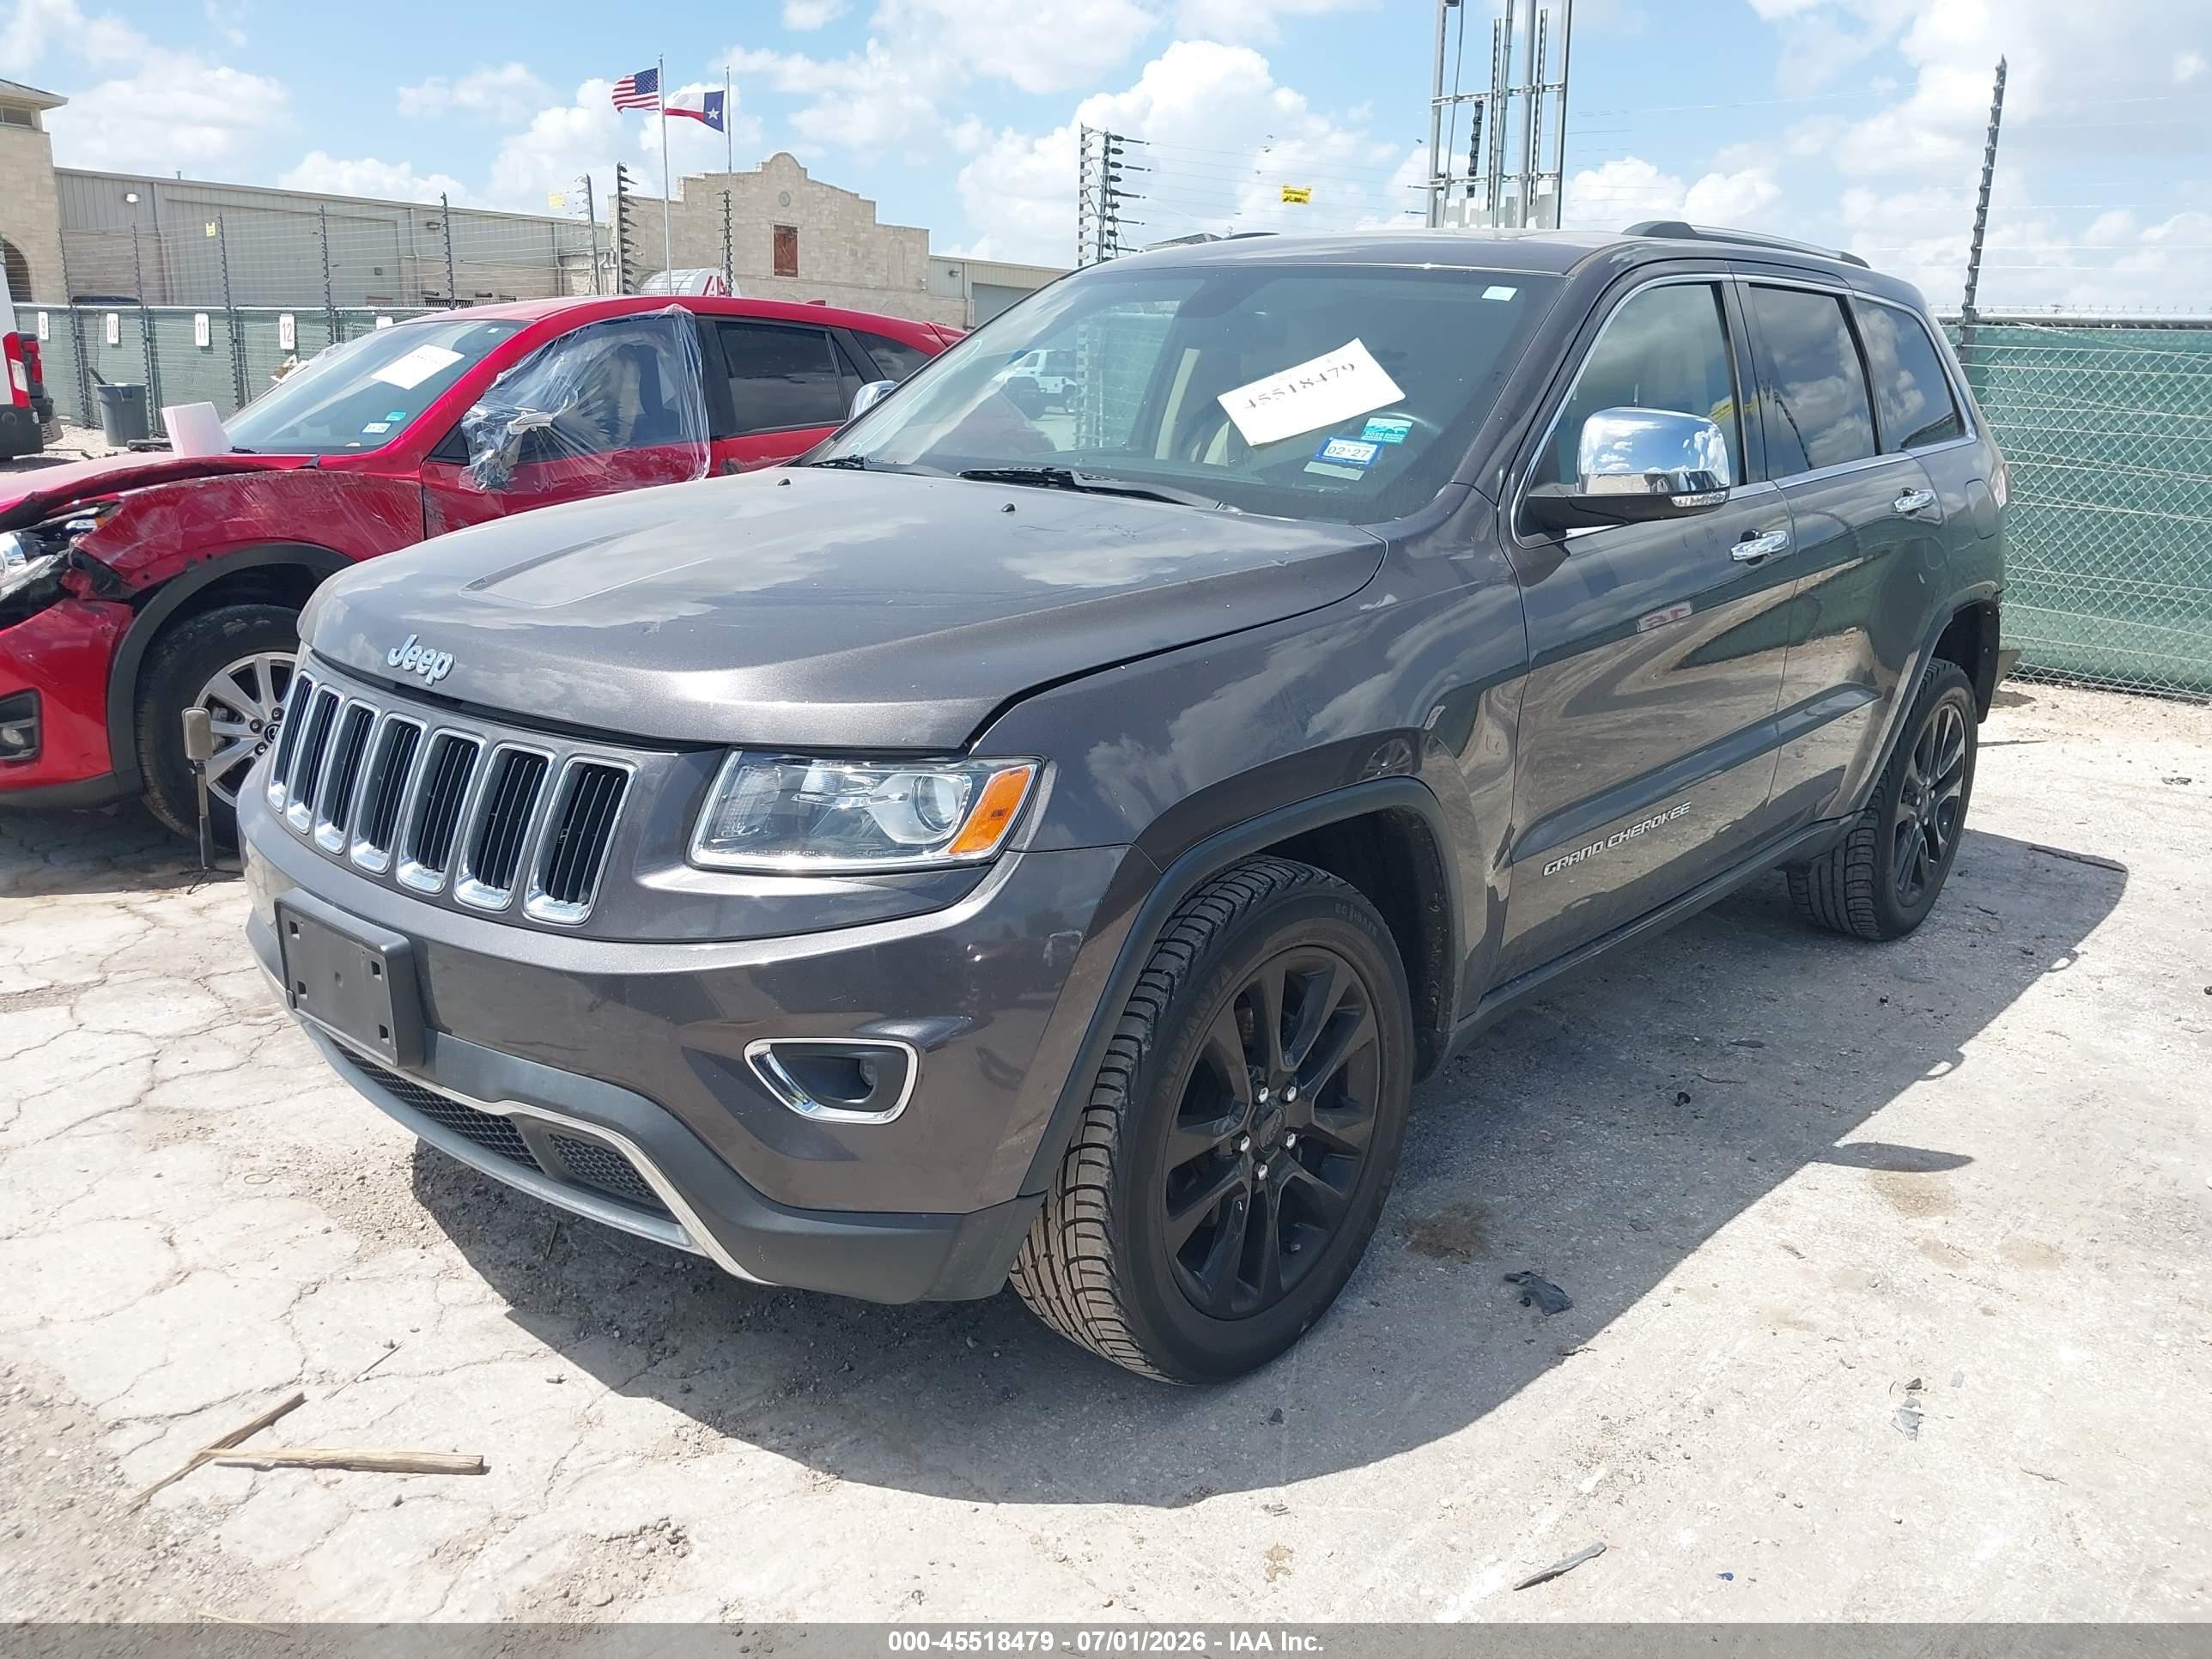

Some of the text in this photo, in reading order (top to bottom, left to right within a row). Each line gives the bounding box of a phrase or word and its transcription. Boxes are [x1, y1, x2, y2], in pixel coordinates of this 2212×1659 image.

[108, 320, 118, 338] 10
[198, 322, 207, 340] 11
[282, 323, 293, 342] 12
[387, 634, 454, 686] Jeep
[1542, 801, 1692, 877] GRAND CHEROKEE
